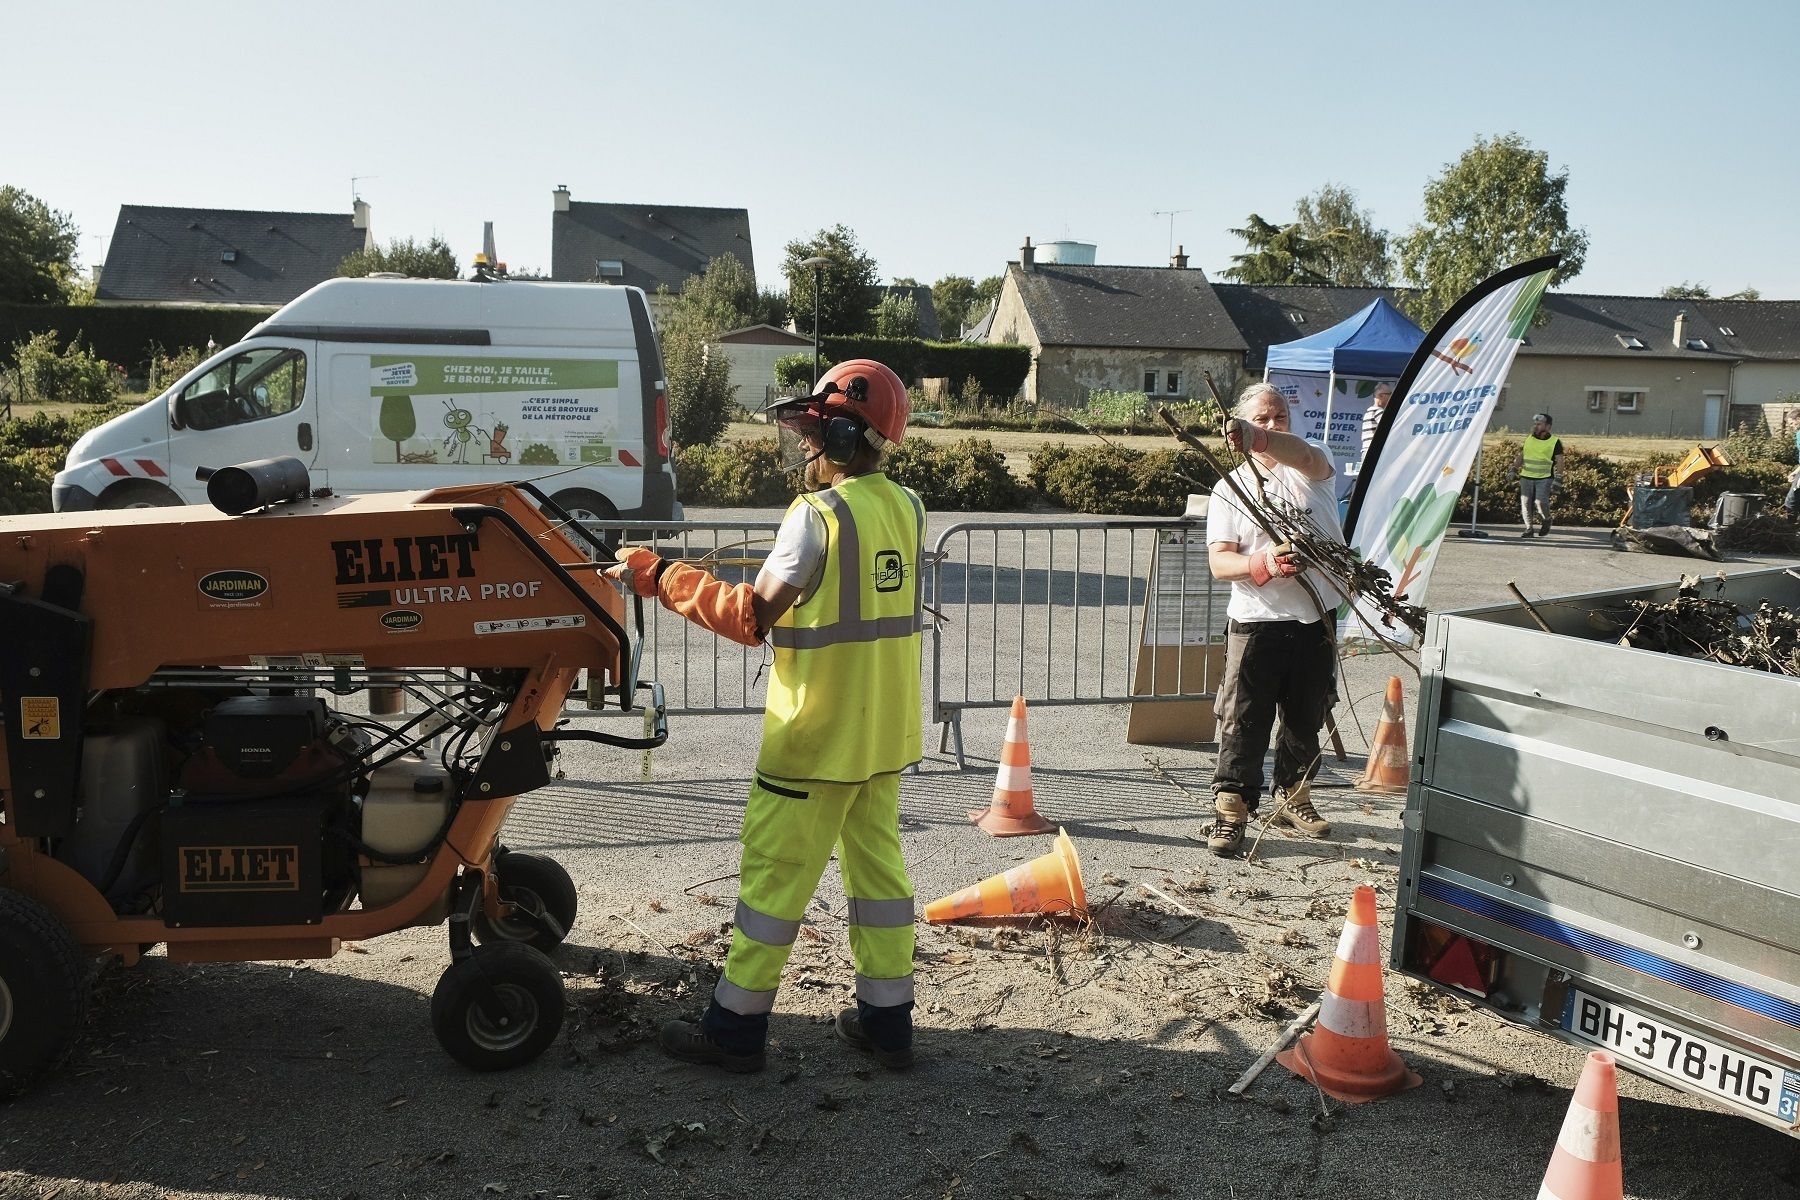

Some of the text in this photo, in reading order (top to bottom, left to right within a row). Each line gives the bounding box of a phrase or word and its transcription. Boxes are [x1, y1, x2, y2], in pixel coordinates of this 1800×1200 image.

[443, 365, 553, 376] CHEZ MOI, JE TAILLE,
[443, 375, 557, 385] JE BROIE, JE PAILLE...
[545, 412, 591, 420] MÉTROPOLE
[1303, 410, 1362, 421] COMOSTER
[1305, 432, 1345, 442] PAILER
[331, 534, 480, 585] ELIET
[206, 580, 261, 591] JARDIMAN
[395, 581, 542, 605] ULTRA PROF
[384, 615, 418, 624] JARDIMAN
[183, 848, 294, 882] ELIET
[1580, 997, 1772, 1106] BH-378-HG
